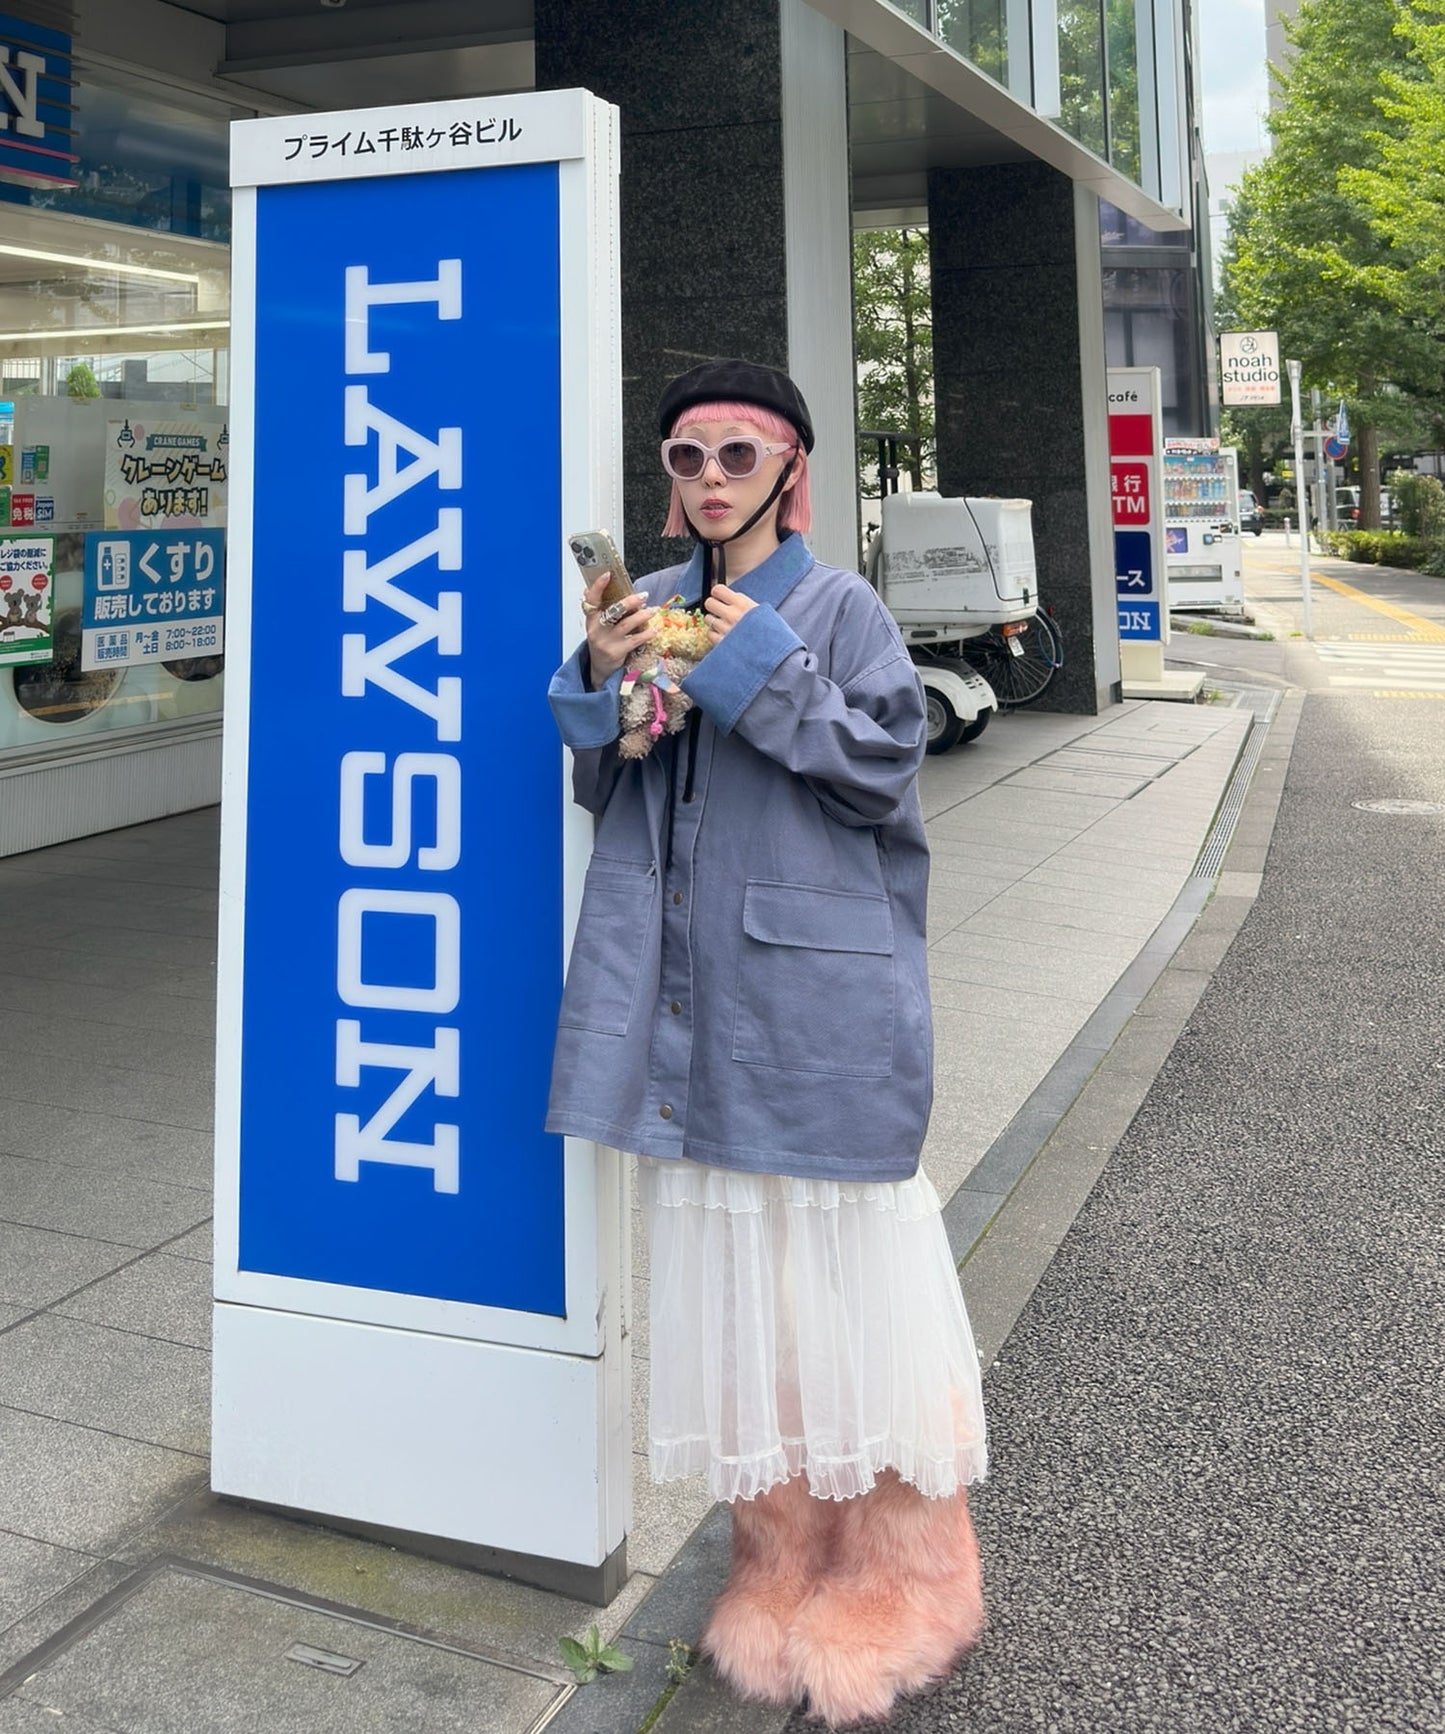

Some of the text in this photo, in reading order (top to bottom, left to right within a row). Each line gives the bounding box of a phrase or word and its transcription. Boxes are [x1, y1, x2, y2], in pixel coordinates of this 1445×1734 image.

[283, 117, 523, 160] プライム千駄ヶ谷ビル
[1228, 353, 1272, 368] noah
[1223, 368, 1279, 382] studio
[1108, 390, 1138, 402] café
[153, 436, 200, 447] CRANE GAMES
[120, 453, 227, 485] クレーンゲーム
[12, 507, 34, 520] 免税
[139, 541, 214, 584] くすり
[94, 588, 216, 620] 販売しております
[143, 642, 159, 655] 土日
[334, 258, 463, 1195] LAWSON
